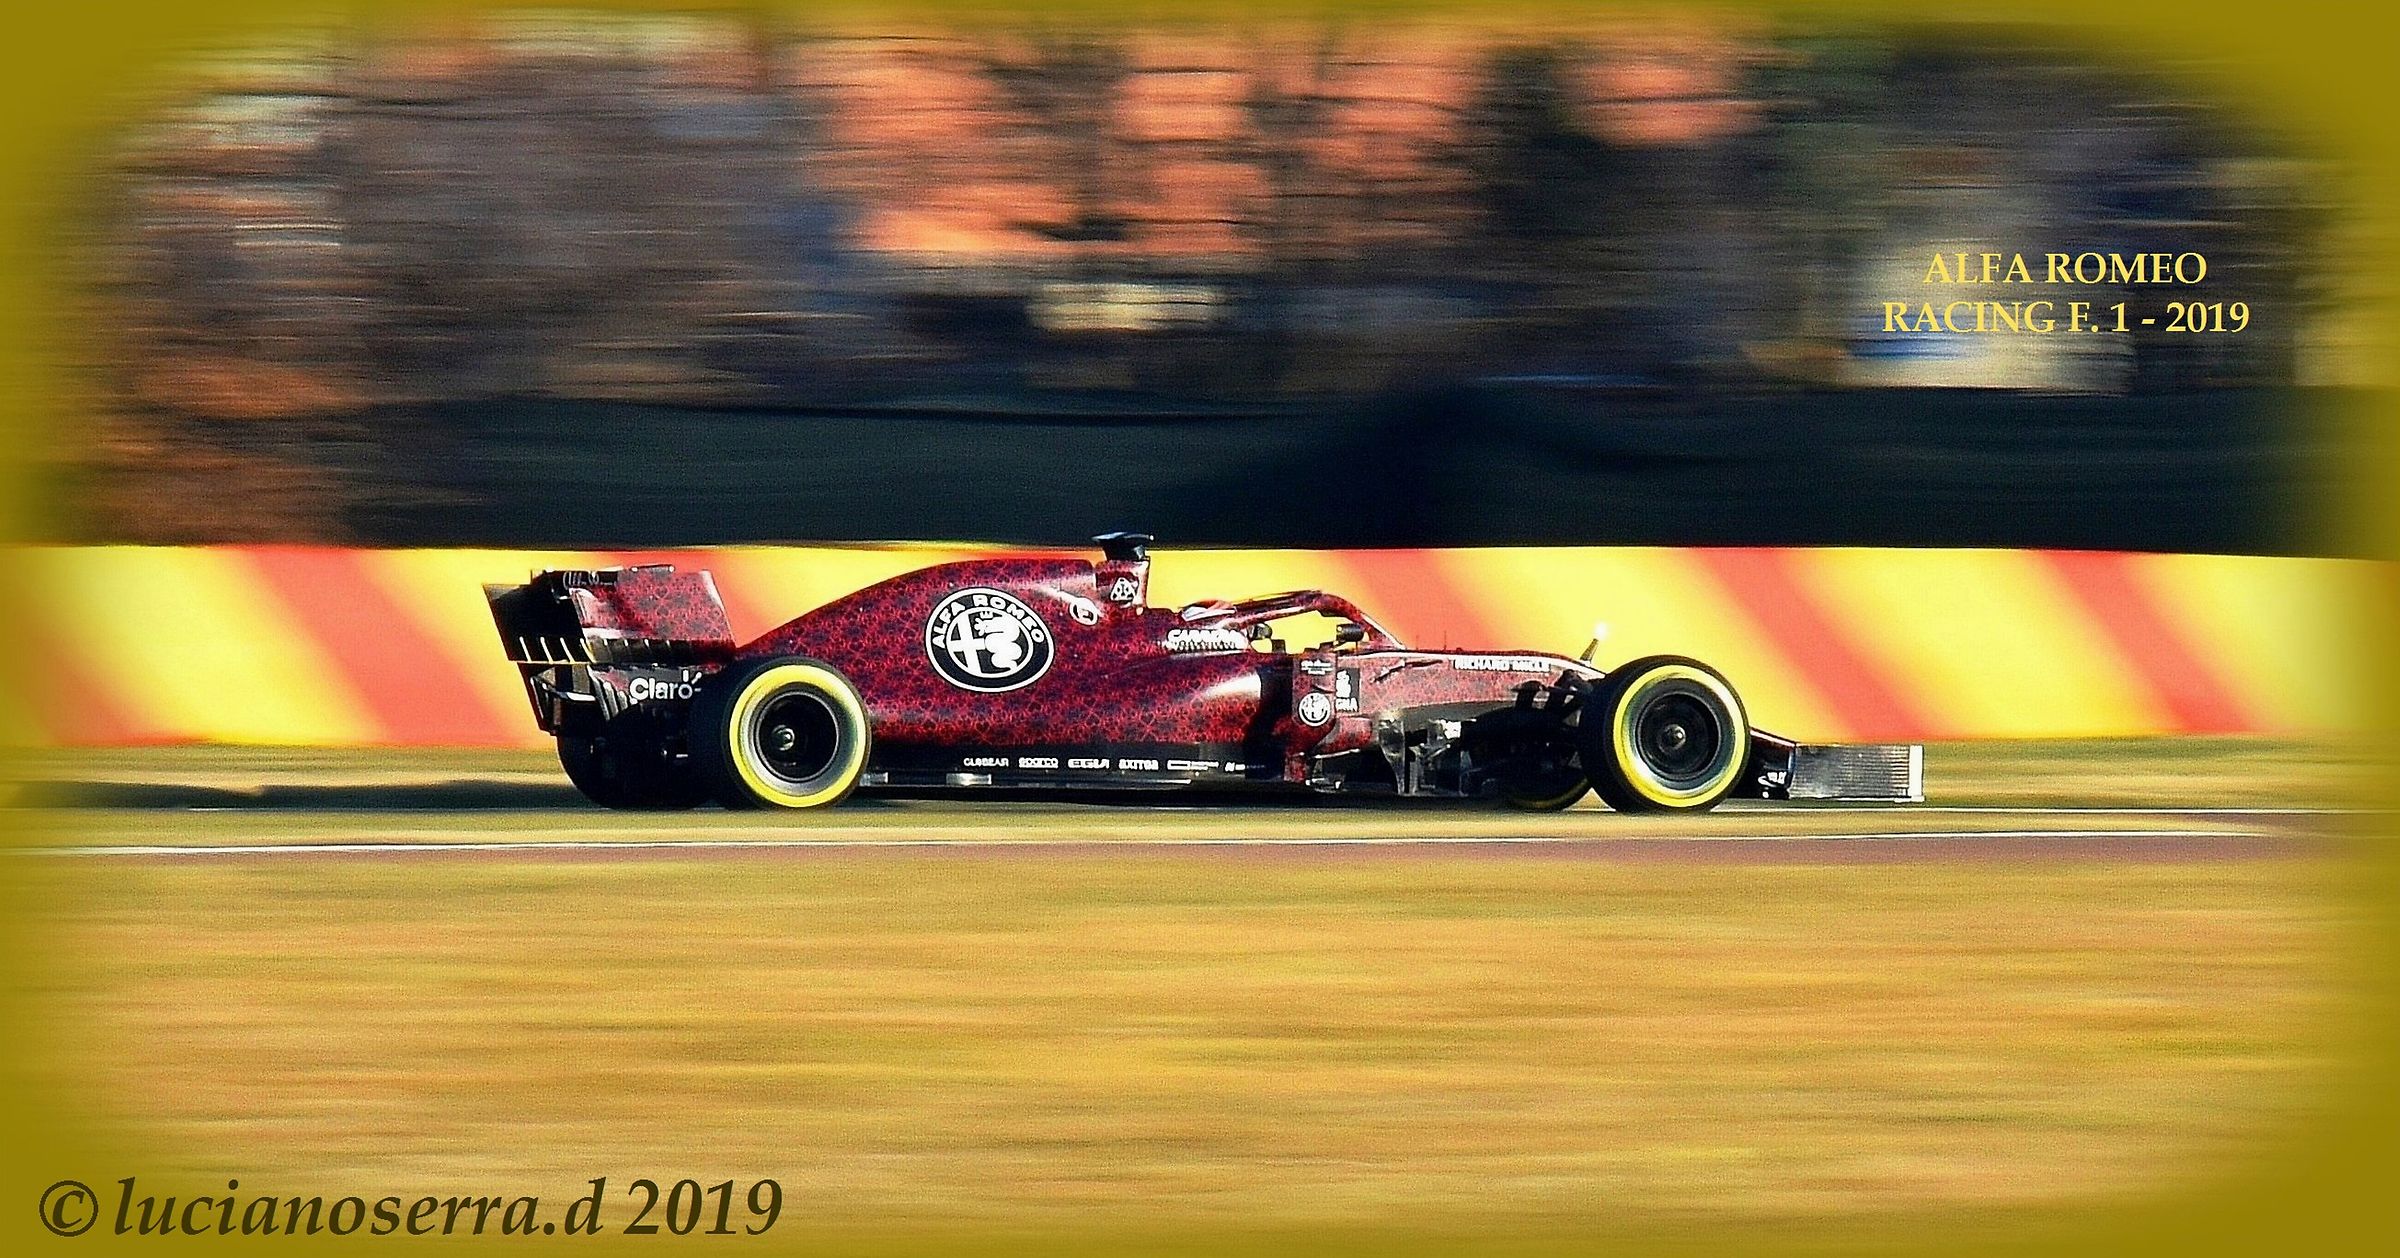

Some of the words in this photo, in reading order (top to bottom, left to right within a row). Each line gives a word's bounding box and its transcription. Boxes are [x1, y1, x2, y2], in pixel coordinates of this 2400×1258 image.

[932, 600, 966, 650] ALFA
[972, 594, 1045, 644] ROMEO
[629, 672, 699, 701] Claro
